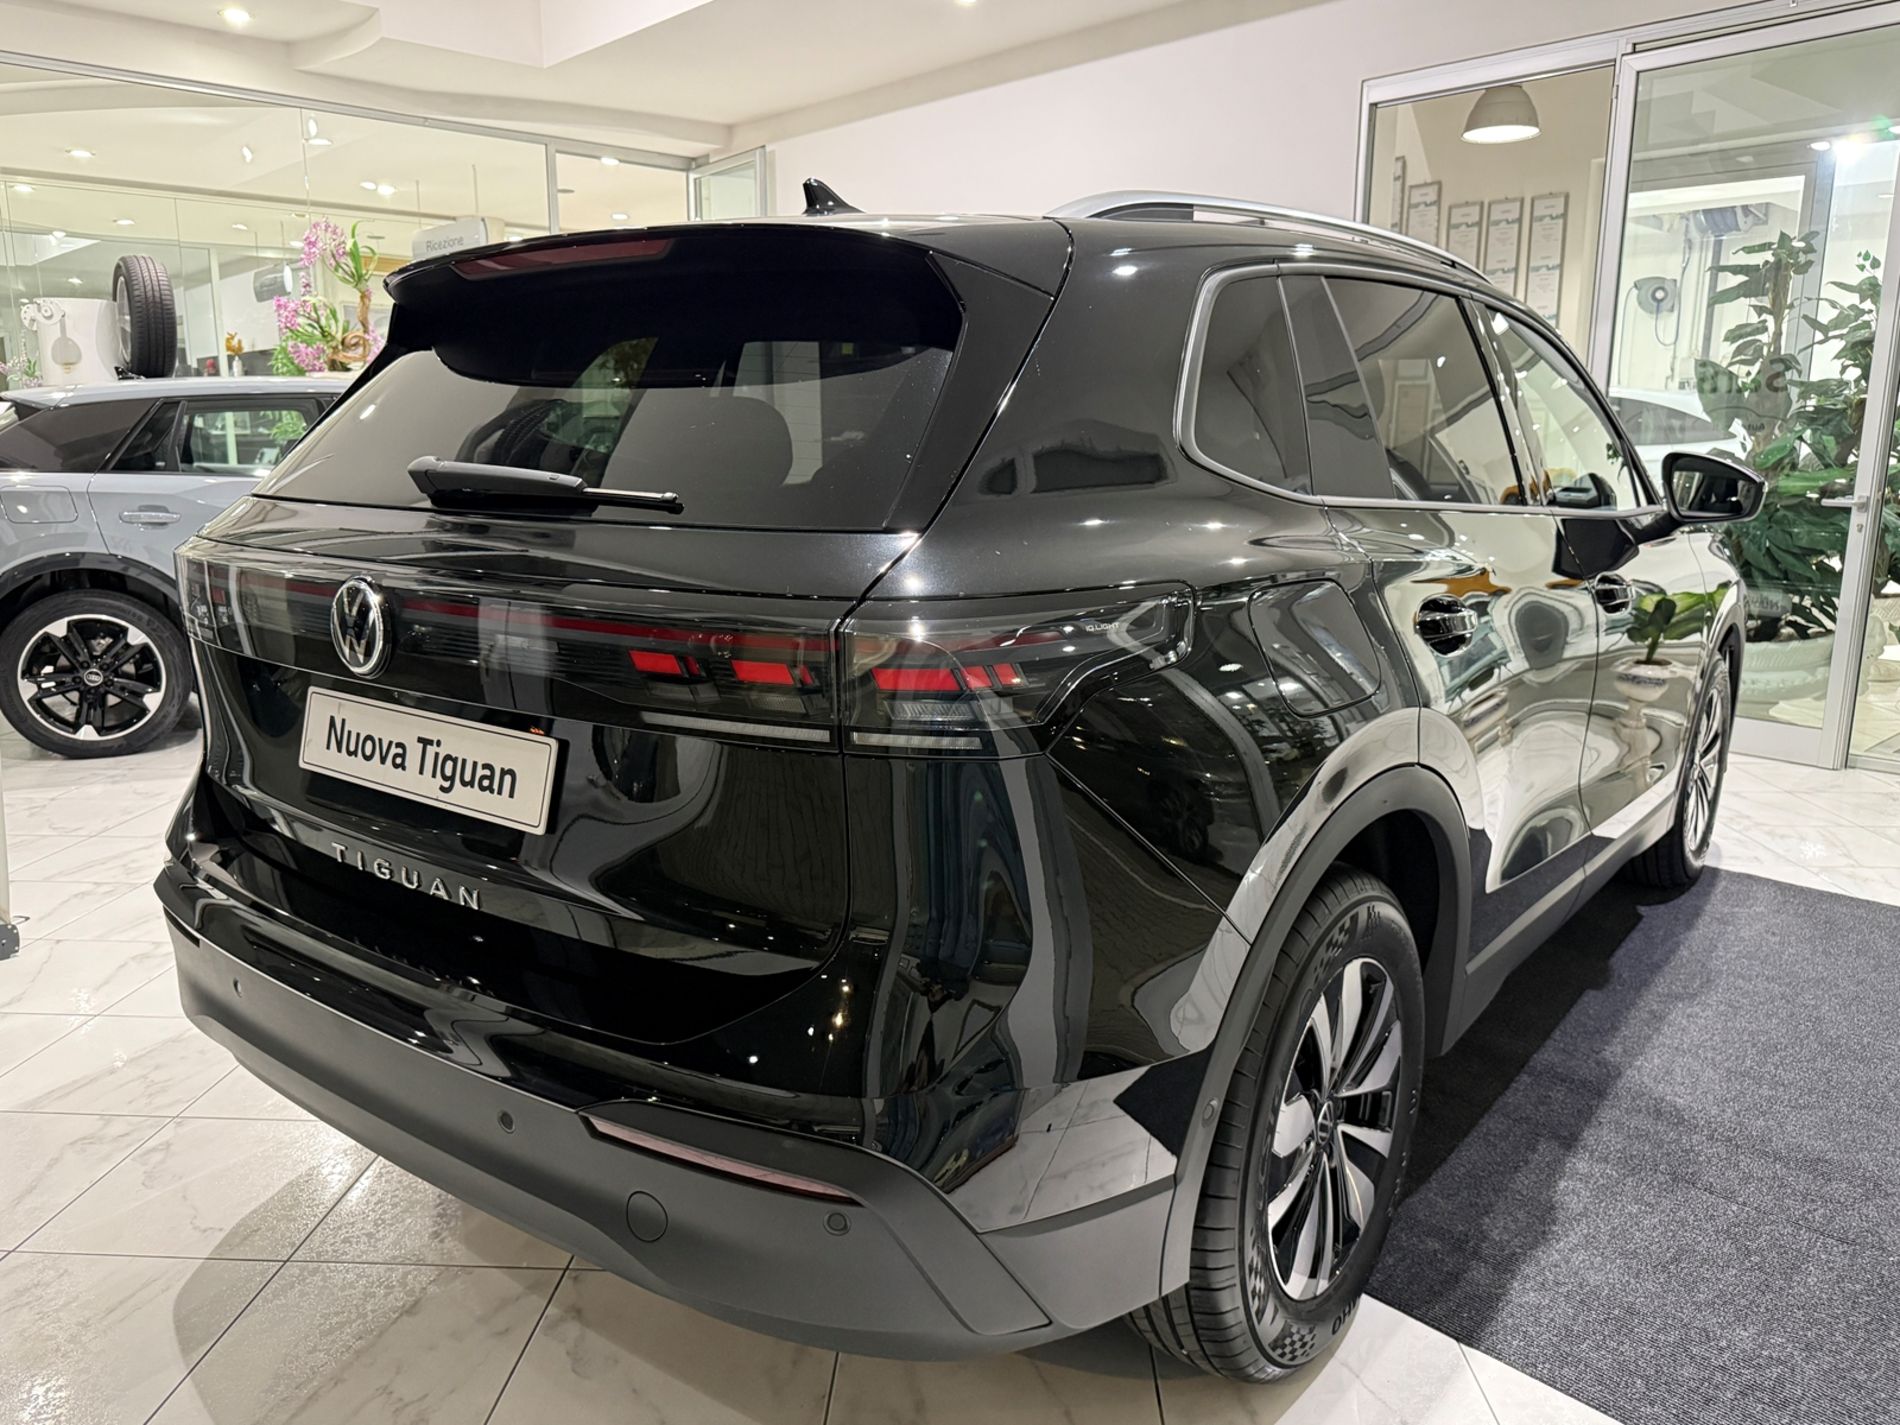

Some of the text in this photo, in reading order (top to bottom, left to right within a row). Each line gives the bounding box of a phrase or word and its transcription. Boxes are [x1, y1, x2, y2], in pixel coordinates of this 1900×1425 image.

[326, 715, 518, 799] Nuova Tiguan
[331, 841, 481, 910] TIGUAN
